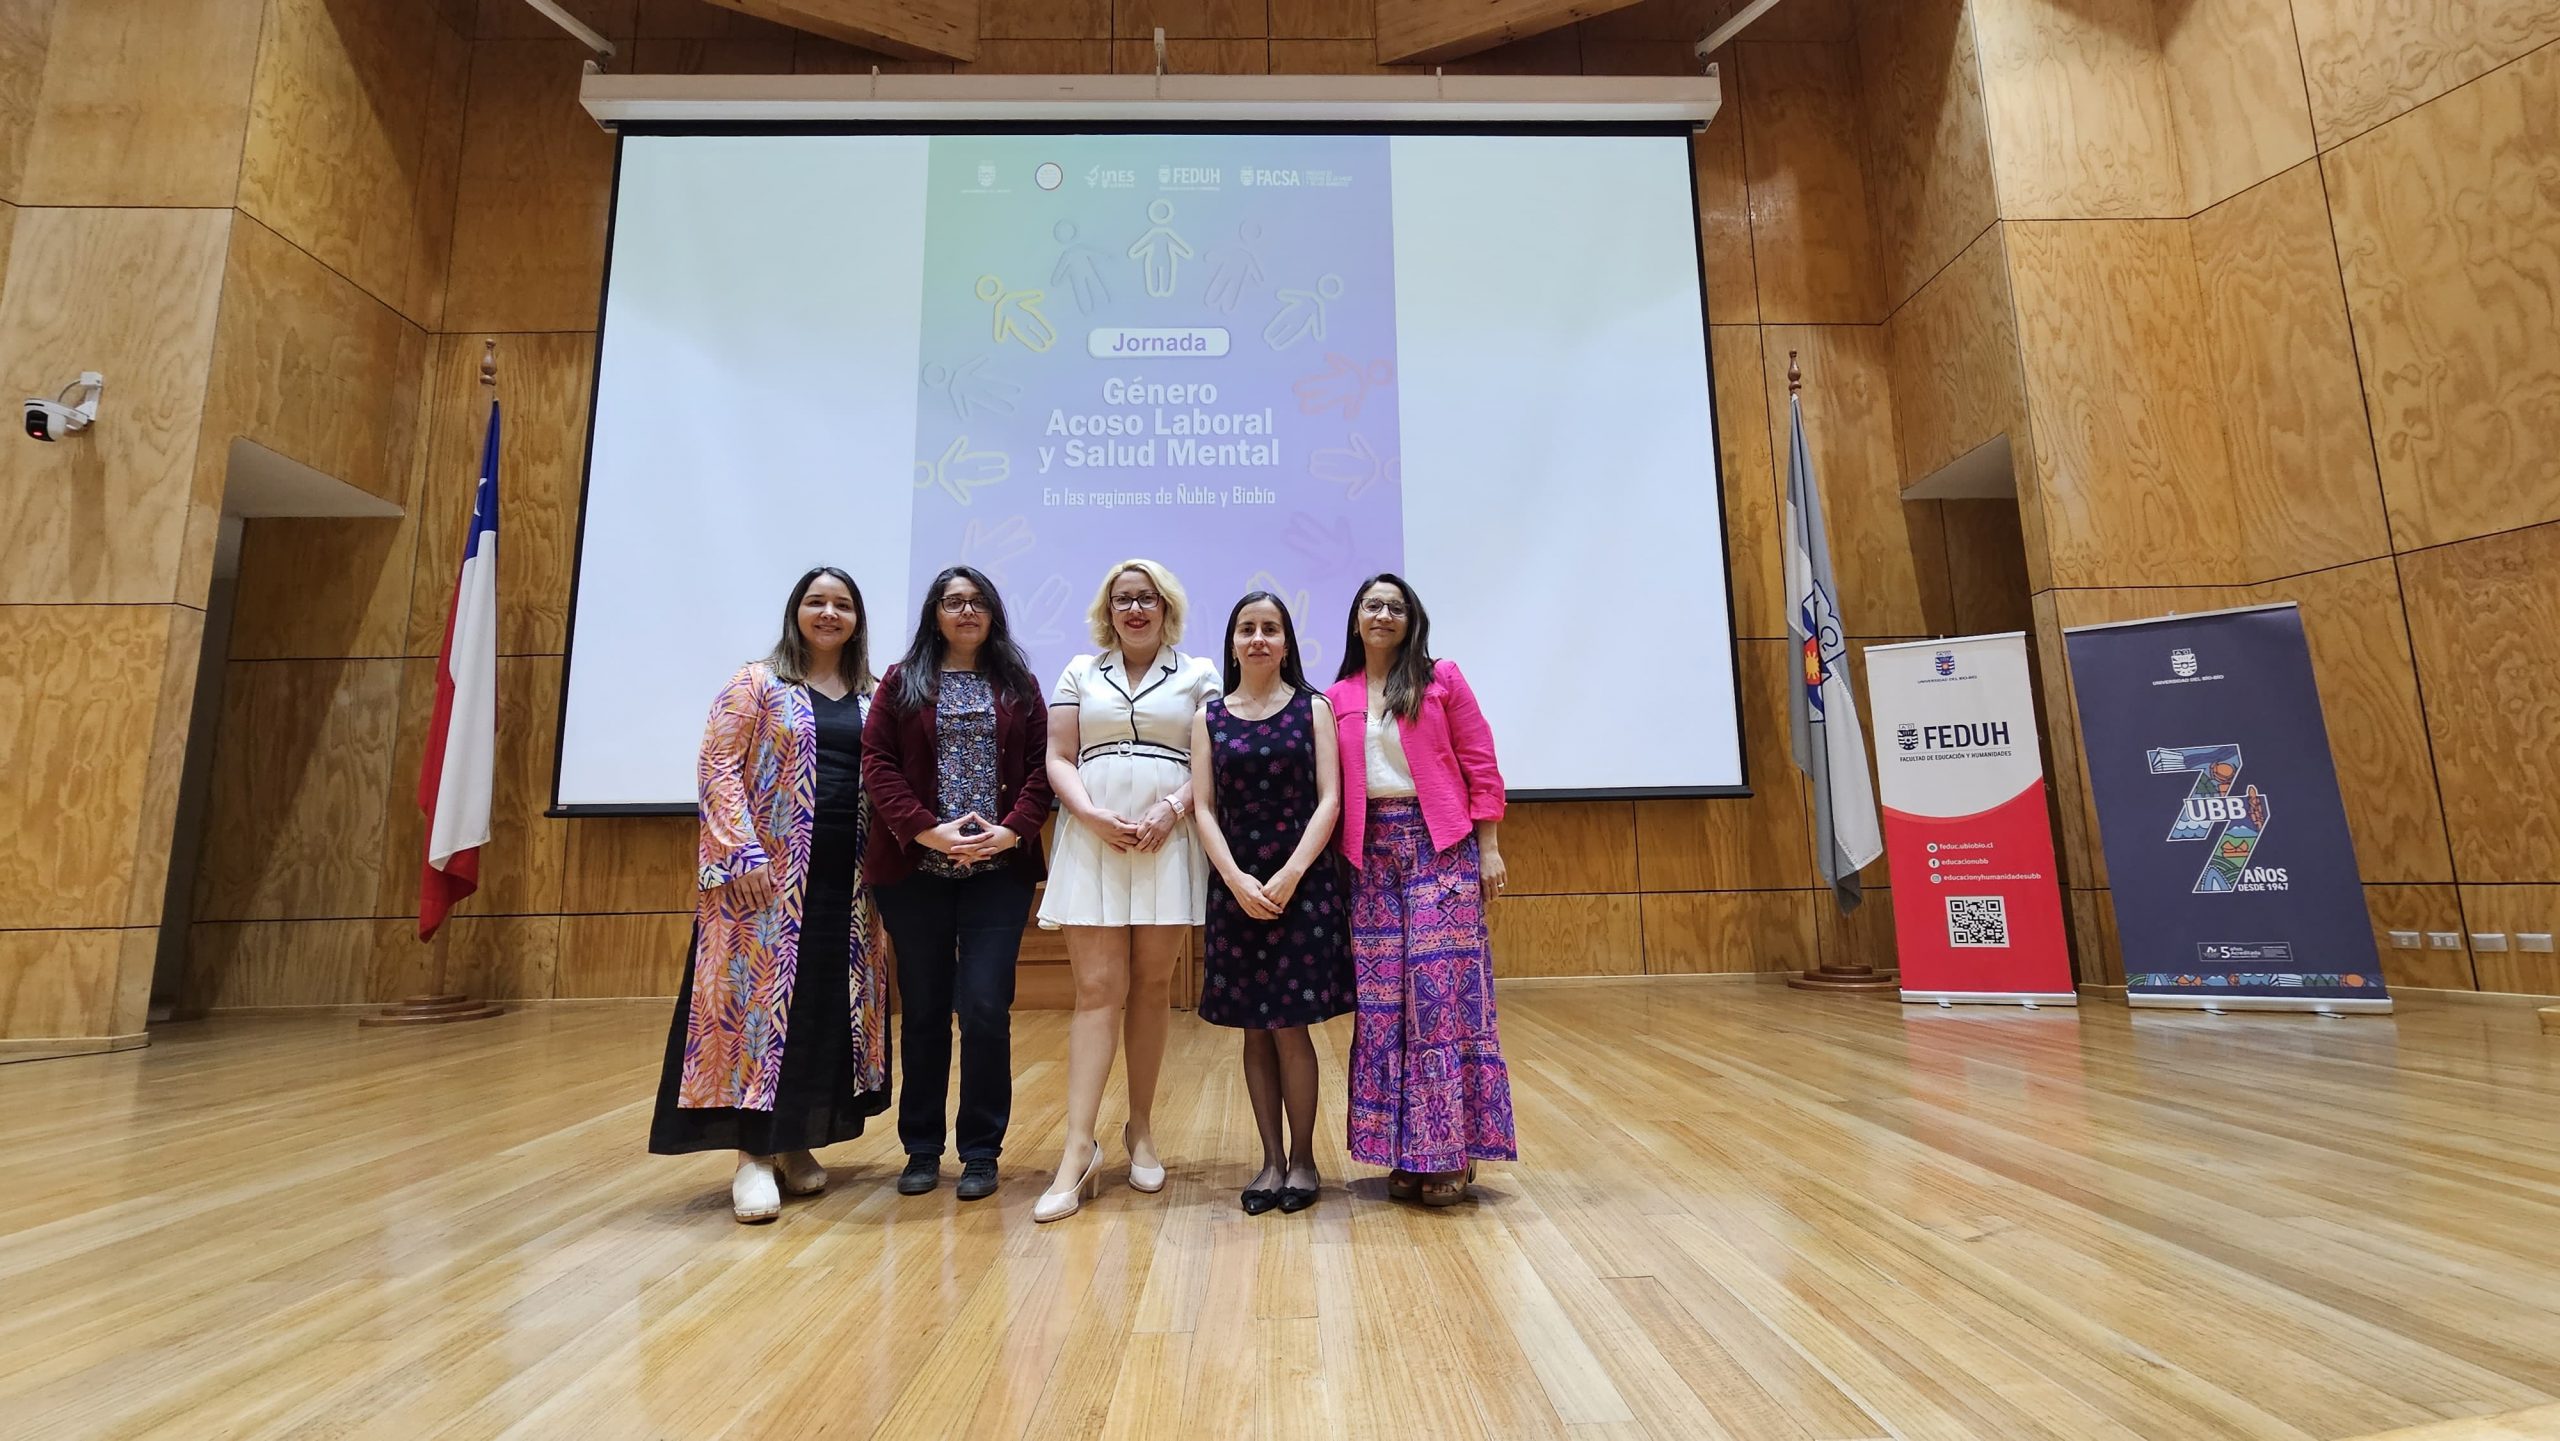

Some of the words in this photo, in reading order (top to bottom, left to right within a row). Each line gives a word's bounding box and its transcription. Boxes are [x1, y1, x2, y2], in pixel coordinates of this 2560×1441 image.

[1173, 167, 1221, 184] FEDUH
[1256, 169, 1301, 187] FACSA
[1112, 333, 1207, 352] Jornada
[1102, 376, 1217, 405] Género
[1045, 408, 1144, 436] Acoso
[1154, 408, 1273, 435] Laboral
[1038, 445, 1056, 474] y
[1064, 438, 1155, 467] Salud
[1167, 438, 1279, 467] Mental
[1043, 487, 1060, 506] En
[1064, 487, 1085, 506] las
[1089, 488, 1151, 509] regiones
[1155, 486, 1172, 505] de
[1176, 483, 1216, 505] Ñuble
[1219, 490, 1228, 507] y
[1923, 721, 2010, 750] FEDUH
[1935, 753, 1965, 761] EDUCACIÓN
[1971, 750, 2012, 758] HUMANIDADES
[2185, 798, 2247, 821] UBB
[1941, 858, 1989, 866] educacionubb
[2243, 866, 2288, 883] AÑOS
[2238, 883, 2265, 892] DESDE
[2266, 882, 2289, 891] 1947
[2220, 946, 2231, 958] 5
